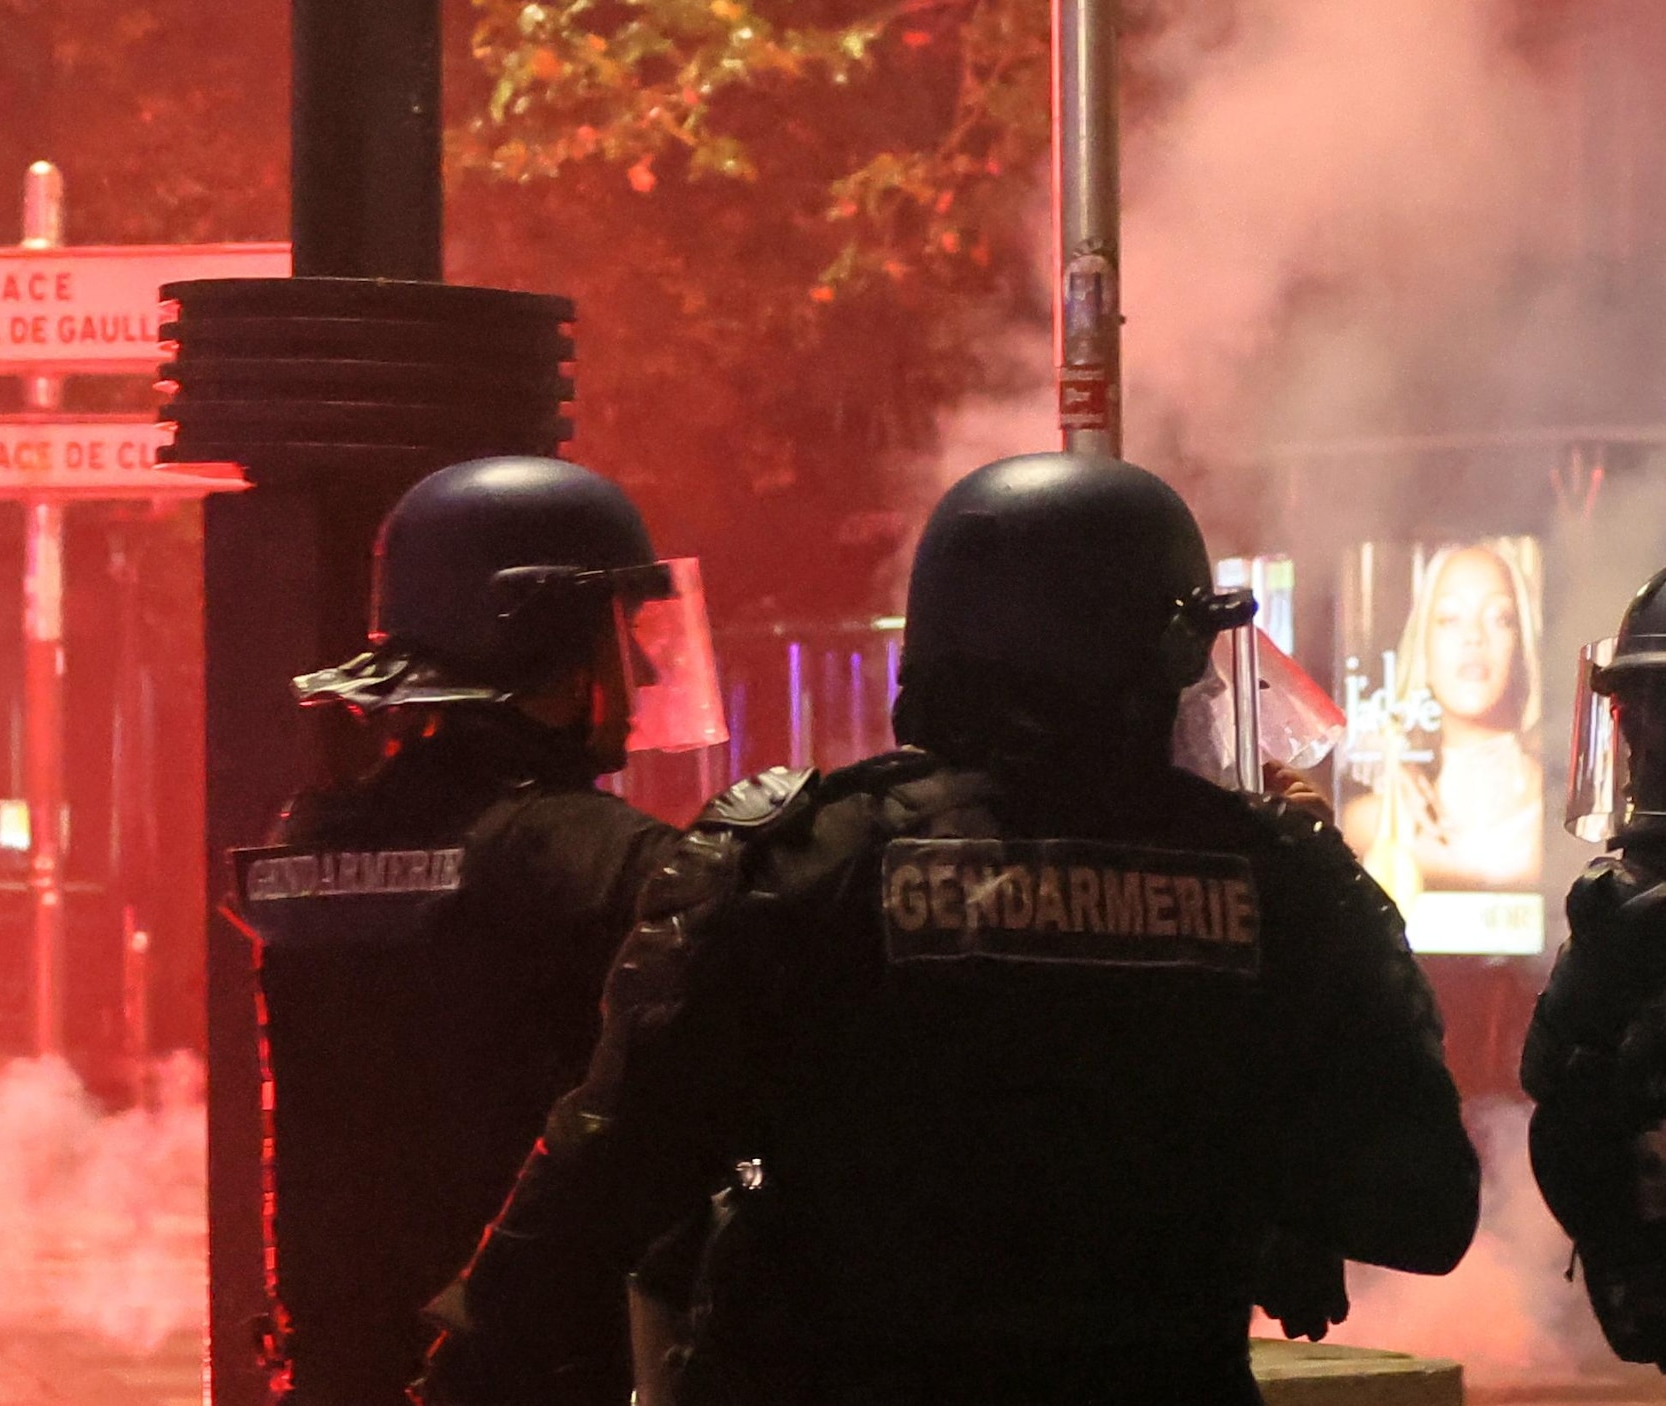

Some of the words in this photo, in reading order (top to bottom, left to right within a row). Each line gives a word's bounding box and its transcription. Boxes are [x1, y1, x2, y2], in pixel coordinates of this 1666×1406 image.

[10, 317, 47, 344] DE
[56, 314, 165, 345] GAULL
[64, 442, 104, 470] DE
[118, 443, 156, 469] CL
[890, 864, 1255, 944] GENDARMERIE
